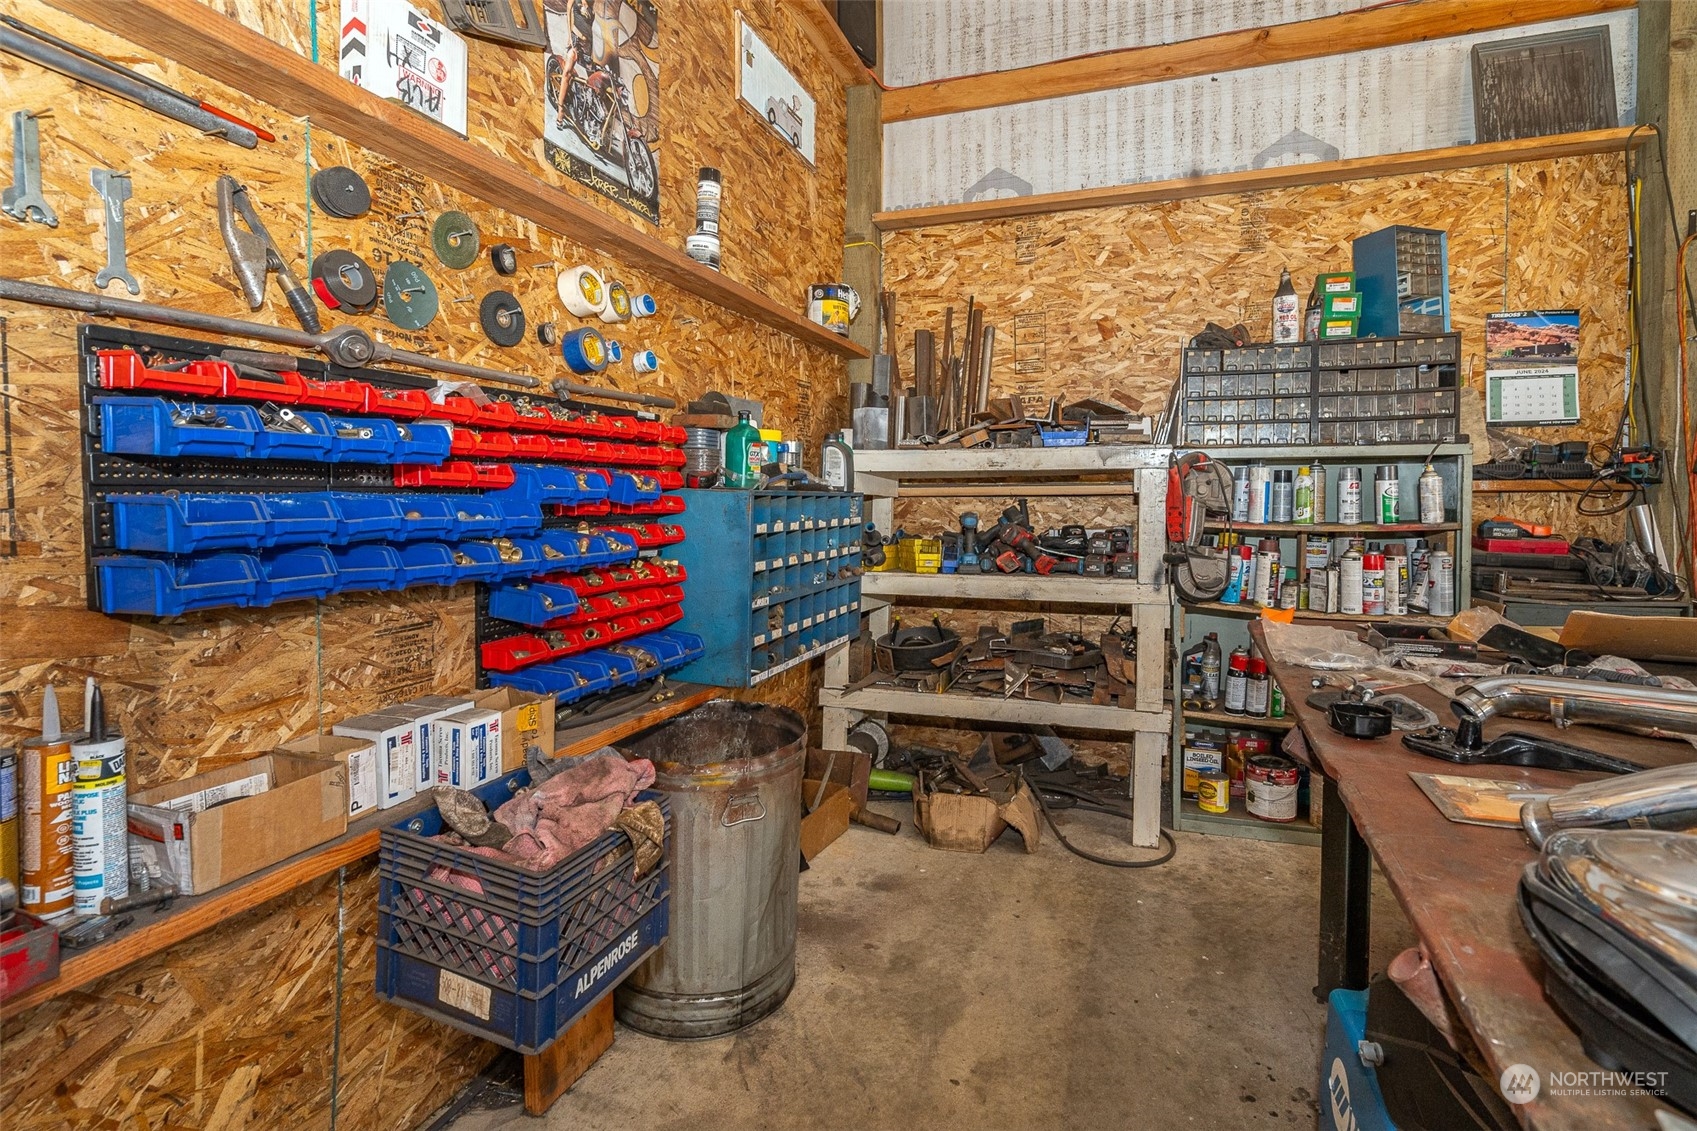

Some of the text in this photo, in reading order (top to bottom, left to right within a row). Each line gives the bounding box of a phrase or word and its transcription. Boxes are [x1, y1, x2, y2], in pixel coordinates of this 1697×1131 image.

[402, 68, 441, 95] WARNING
[529, 707, 537, 727] Ship
[351, 800, 362, 812] P
[574, 930, 639, 999] ALPENROSE
